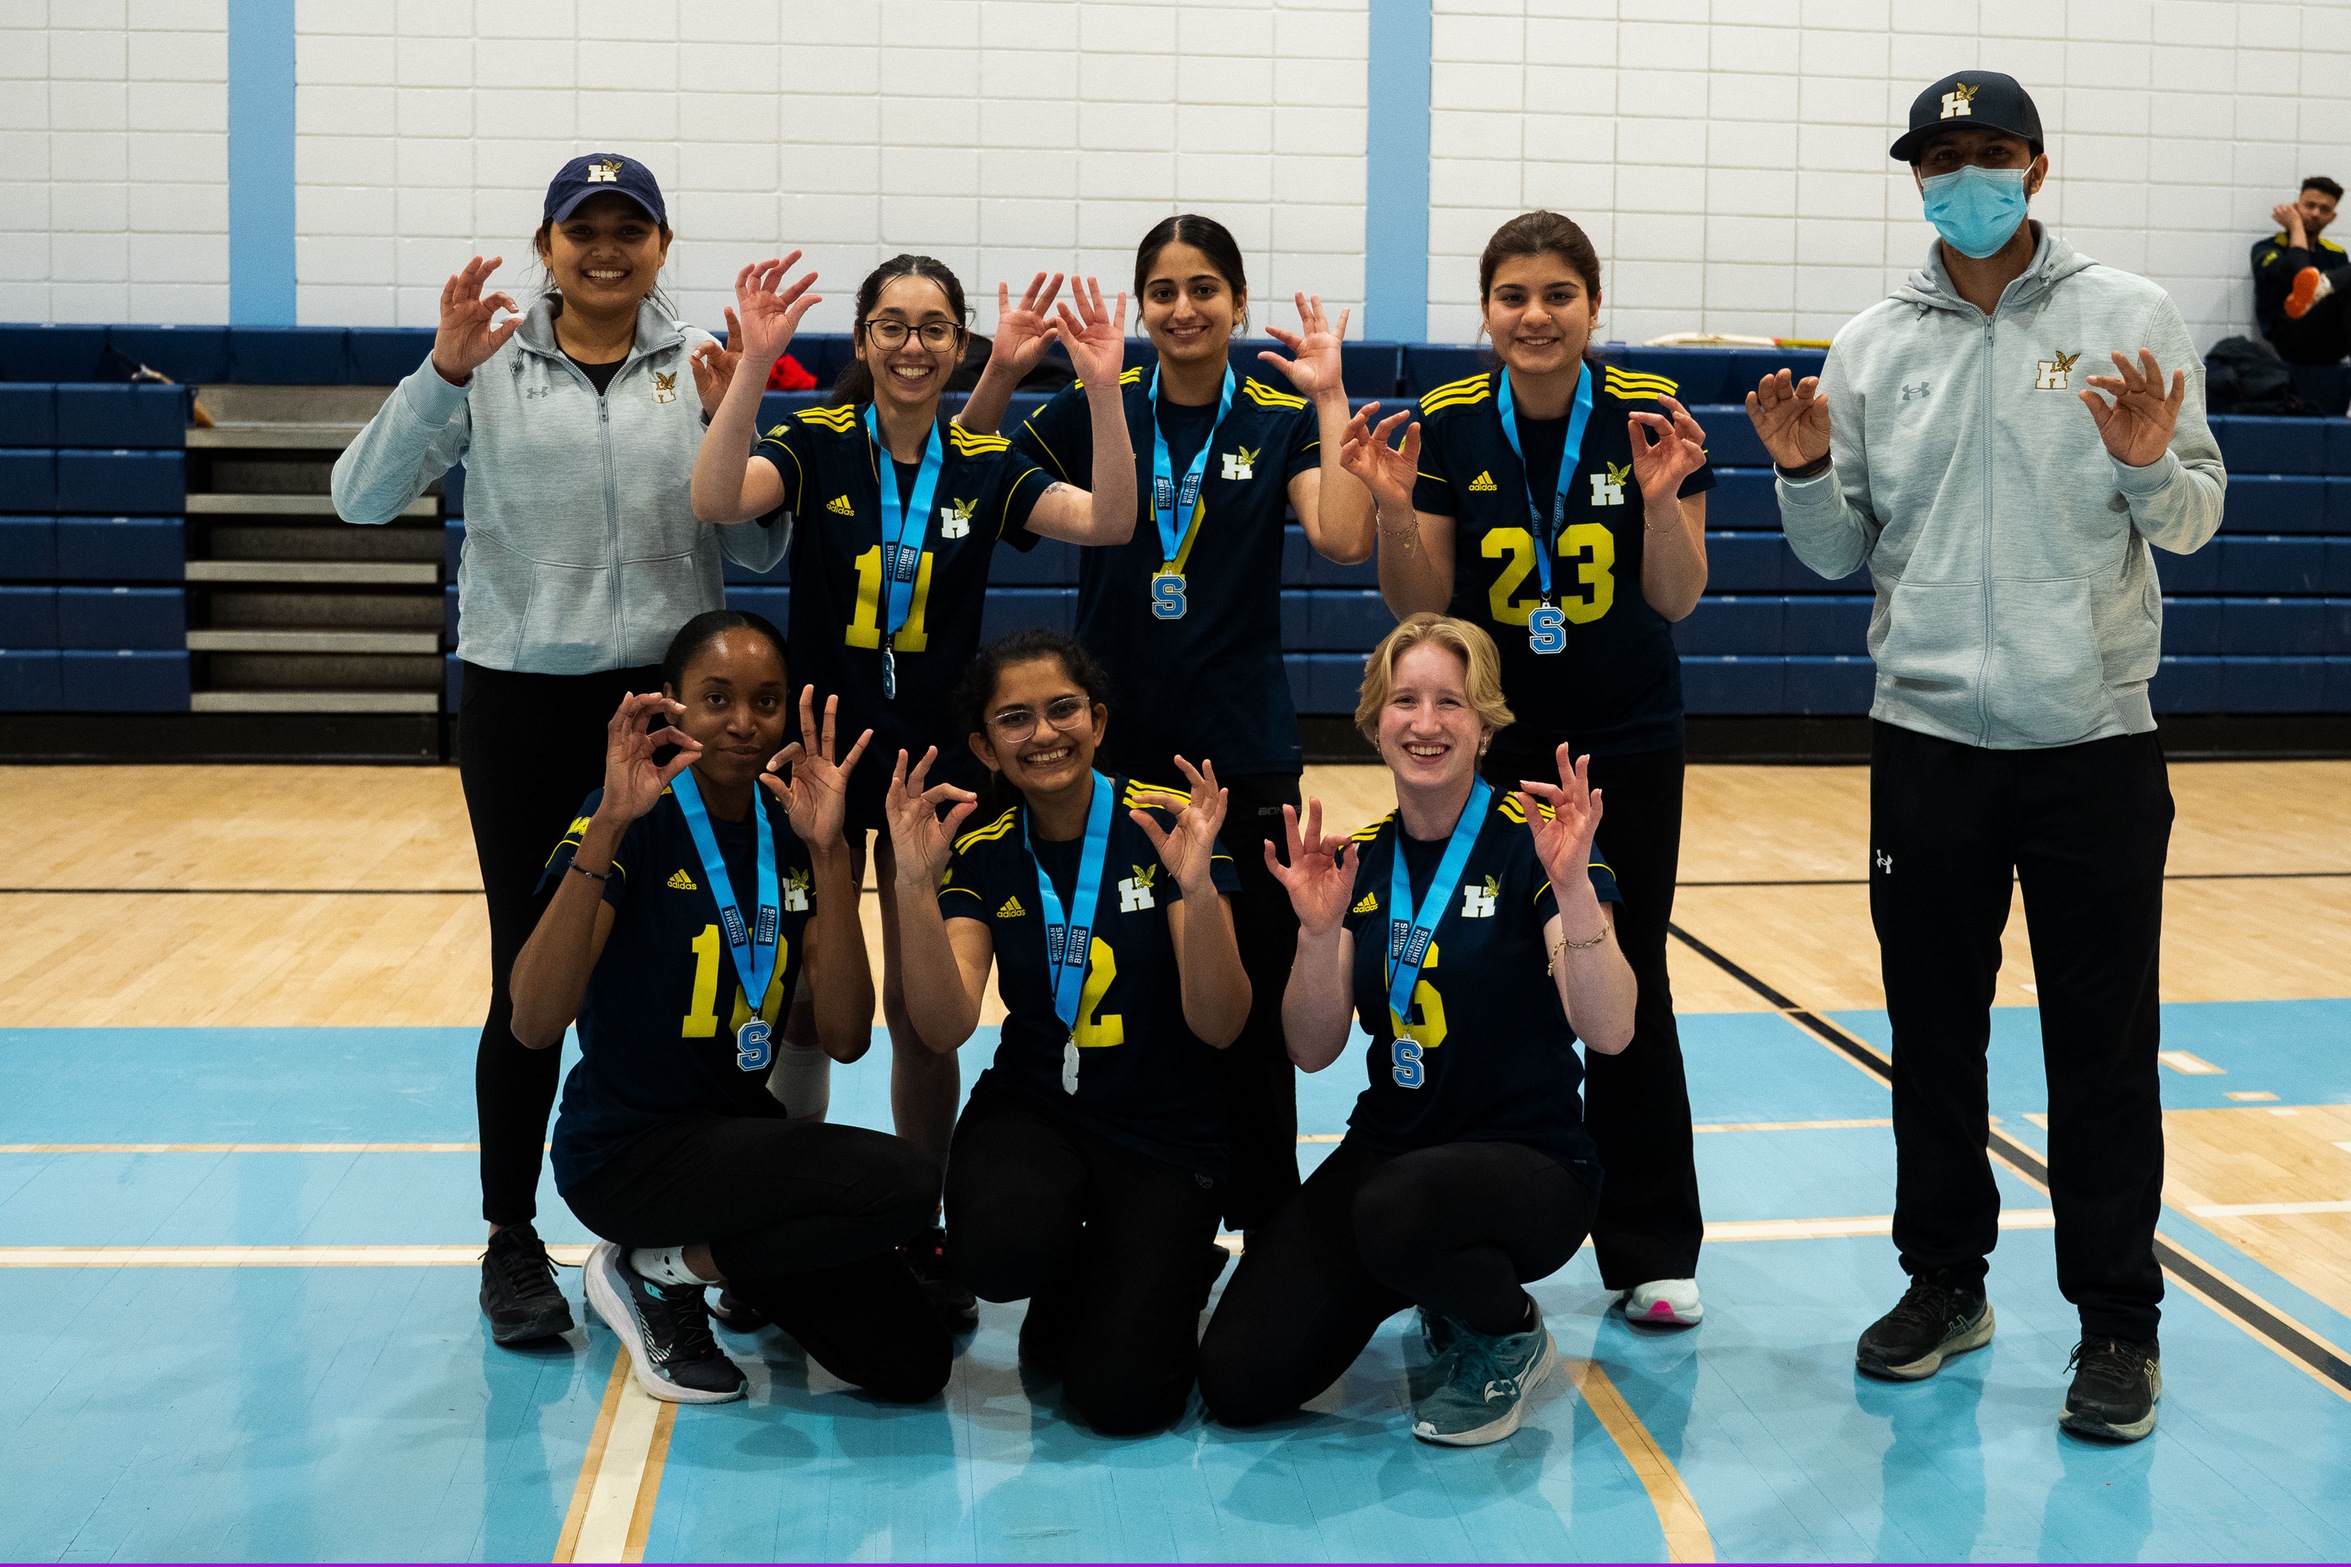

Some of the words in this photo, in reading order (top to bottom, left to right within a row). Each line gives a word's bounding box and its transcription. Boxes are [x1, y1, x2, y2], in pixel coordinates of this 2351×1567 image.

[1941, 91, 1971, 119] H
[588, 164, 617, 182] H
[2035, 361, 2068, 389] H
[1221, 453, 1252, 480] H
[1187, 475, 1199, 504] BRUINS
[1590, 474, 1624, 506] H
[826, 503, 855, 516] adidas
[941, 507, 970, 539] H
[897, 548, 910, 579] BRUINS
[1481, 523, 1615, 626] 23
[845, 545, 934, 652] 11
[1152, 576, 1187, 619] S
[1529, 606, 1566, 654] S
[667, 881, 697, 890] adidas
[1118, 877, 1155, 913] H
[1461, 885, 1495, 918] H
[997, 909, 1026, 918] adidas
[1353, 903, 1378, 913] adidas
[724, 910, 739, 944] BRUINS
[731, 909, 745, 942] SHERIDAN
[759, 908, 768, 942] SHERIDAN
[765, 909, 776, 942] BRUINS
[1068, 929, 1078, 963] SHERIDAN
[1074, 930, 1086, 964] BRUINS
[1405, 929, 1421, 962] SHERIDAN
[1411, 931, 1428, 964] BRUINS
[1074, 936, 1124, 1047] 2
[737, 1020, 771, 1072] S
[1391, 1037, 1424, 1089] S
